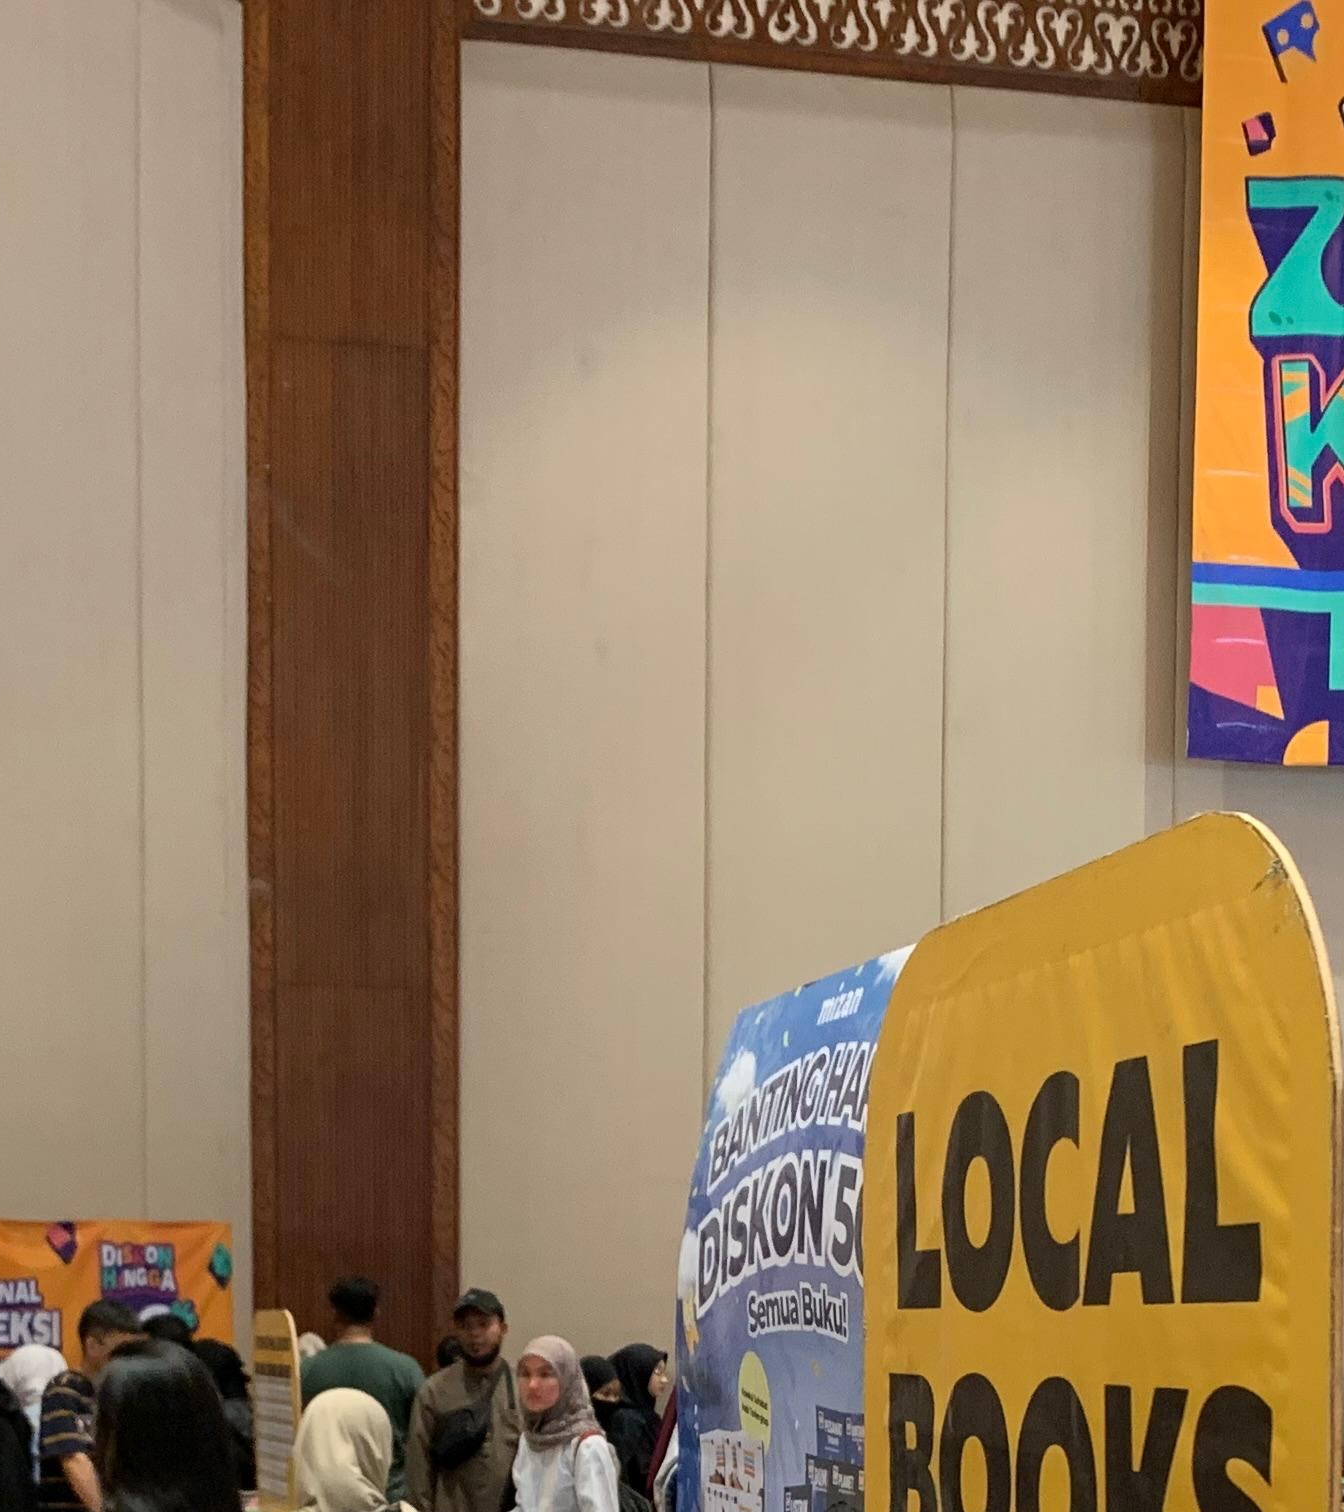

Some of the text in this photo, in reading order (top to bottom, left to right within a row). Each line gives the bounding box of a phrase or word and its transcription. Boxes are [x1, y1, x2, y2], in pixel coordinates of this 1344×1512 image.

[697, 1152, 830, 1316] DISKON
[896, 1038, 1262, 1312] LOCAL
[748, 1286, 848, 1338] Semua Buku!
